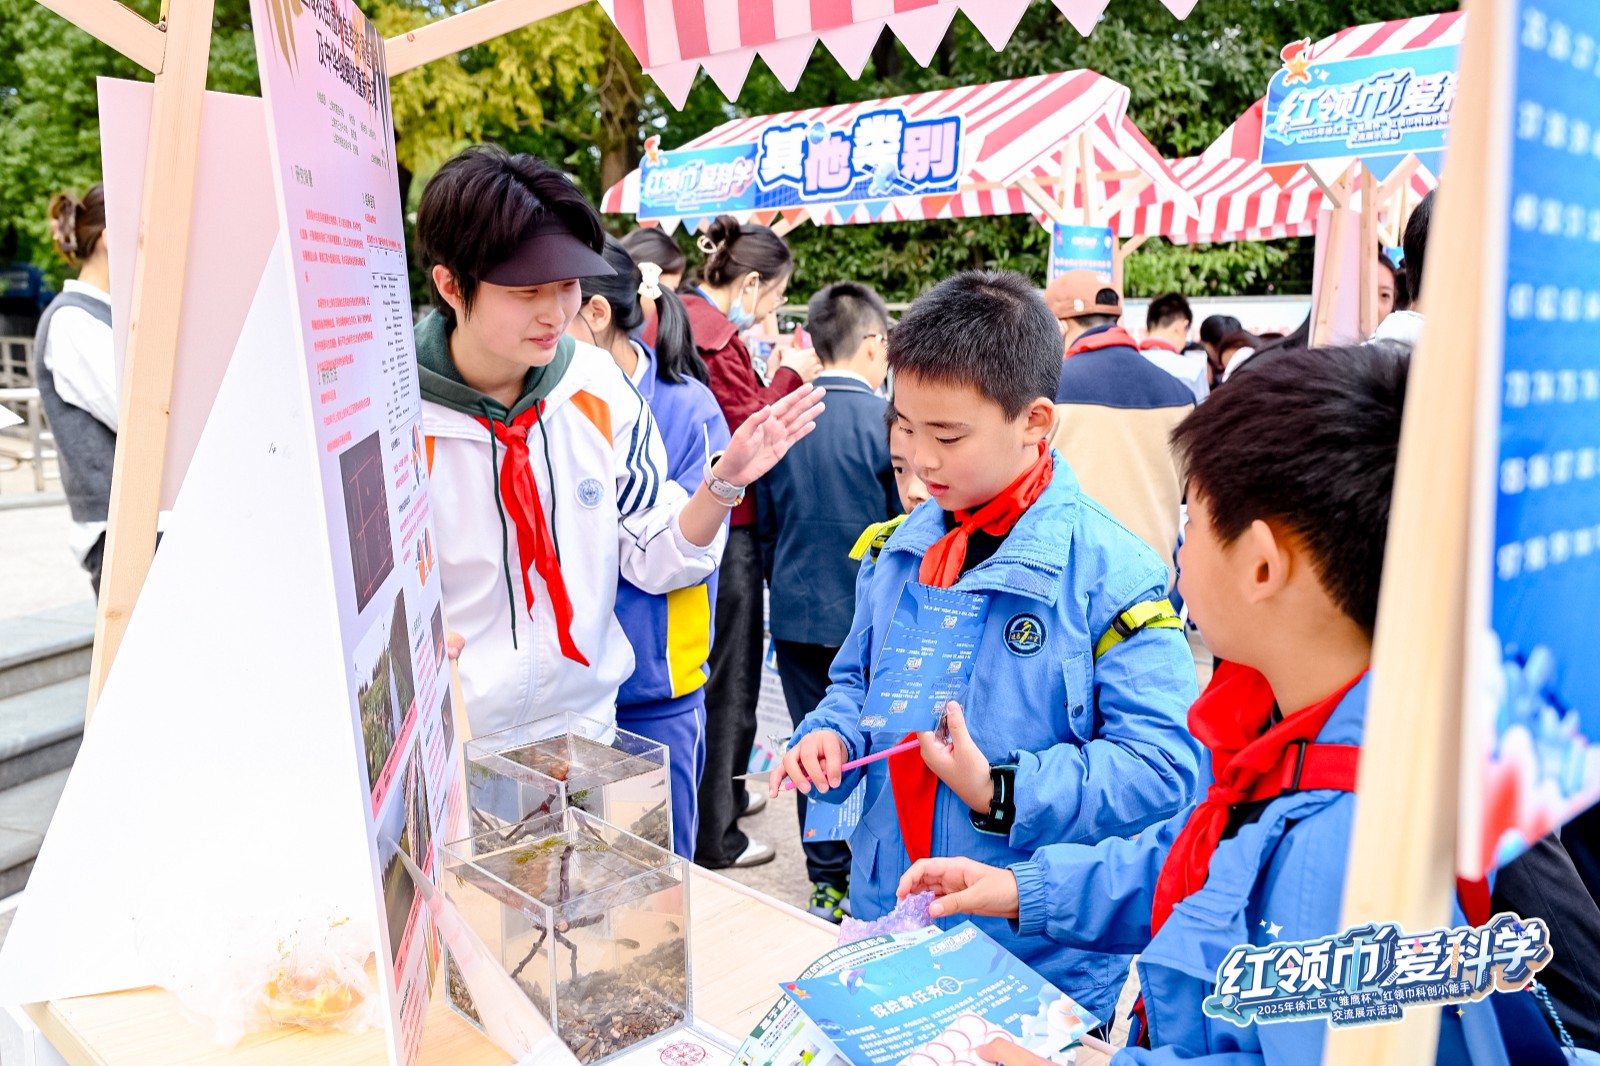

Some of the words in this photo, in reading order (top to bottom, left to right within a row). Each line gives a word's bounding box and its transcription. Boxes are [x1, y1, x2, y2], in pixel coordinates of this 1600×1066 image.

[761, 112, 957, 191] 其他类别
[870, 979, 957, 1018] 探险家任务卡
